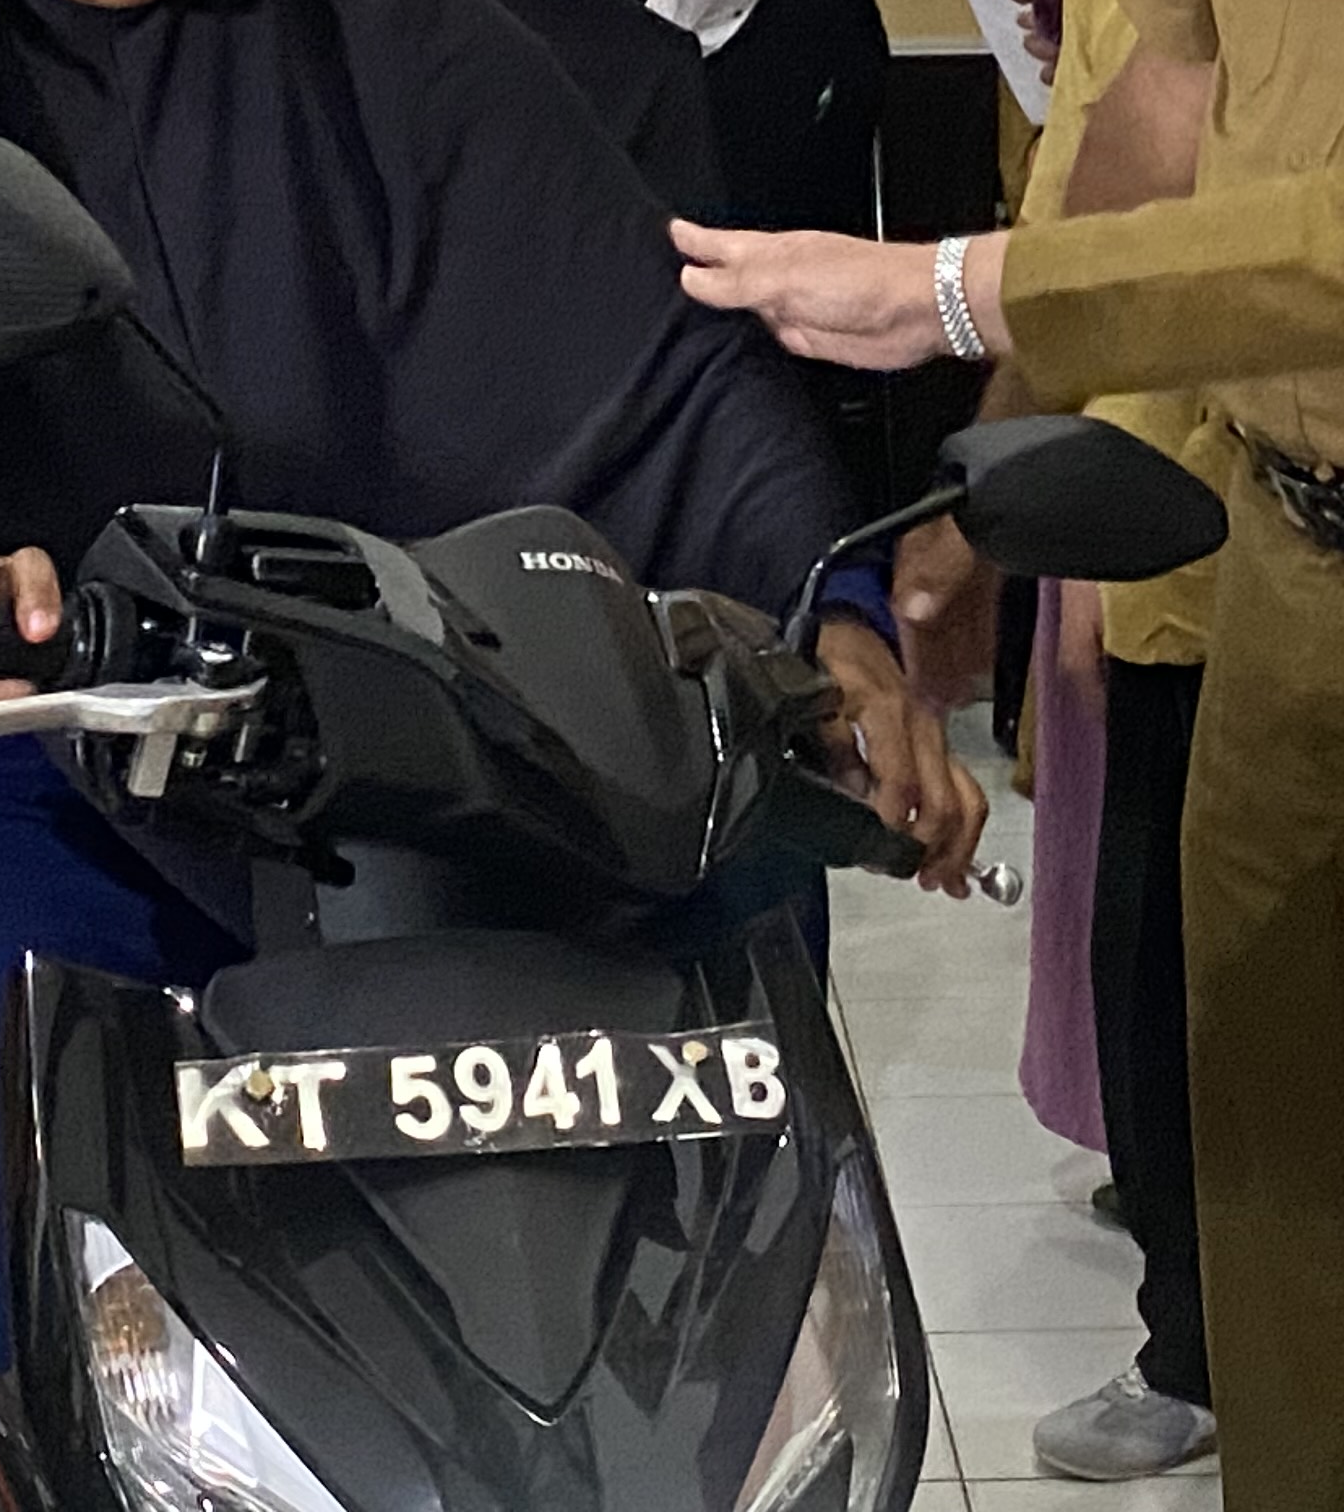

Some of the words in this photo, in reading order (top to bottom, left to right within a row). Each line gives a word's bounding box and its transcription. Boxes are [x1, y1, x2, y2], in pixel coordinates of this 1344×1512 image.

[176, 1060, 348, 1152] KT
[390, 1037, 623, 1142] 5941
[647, 1037, 787, 1125] XB
